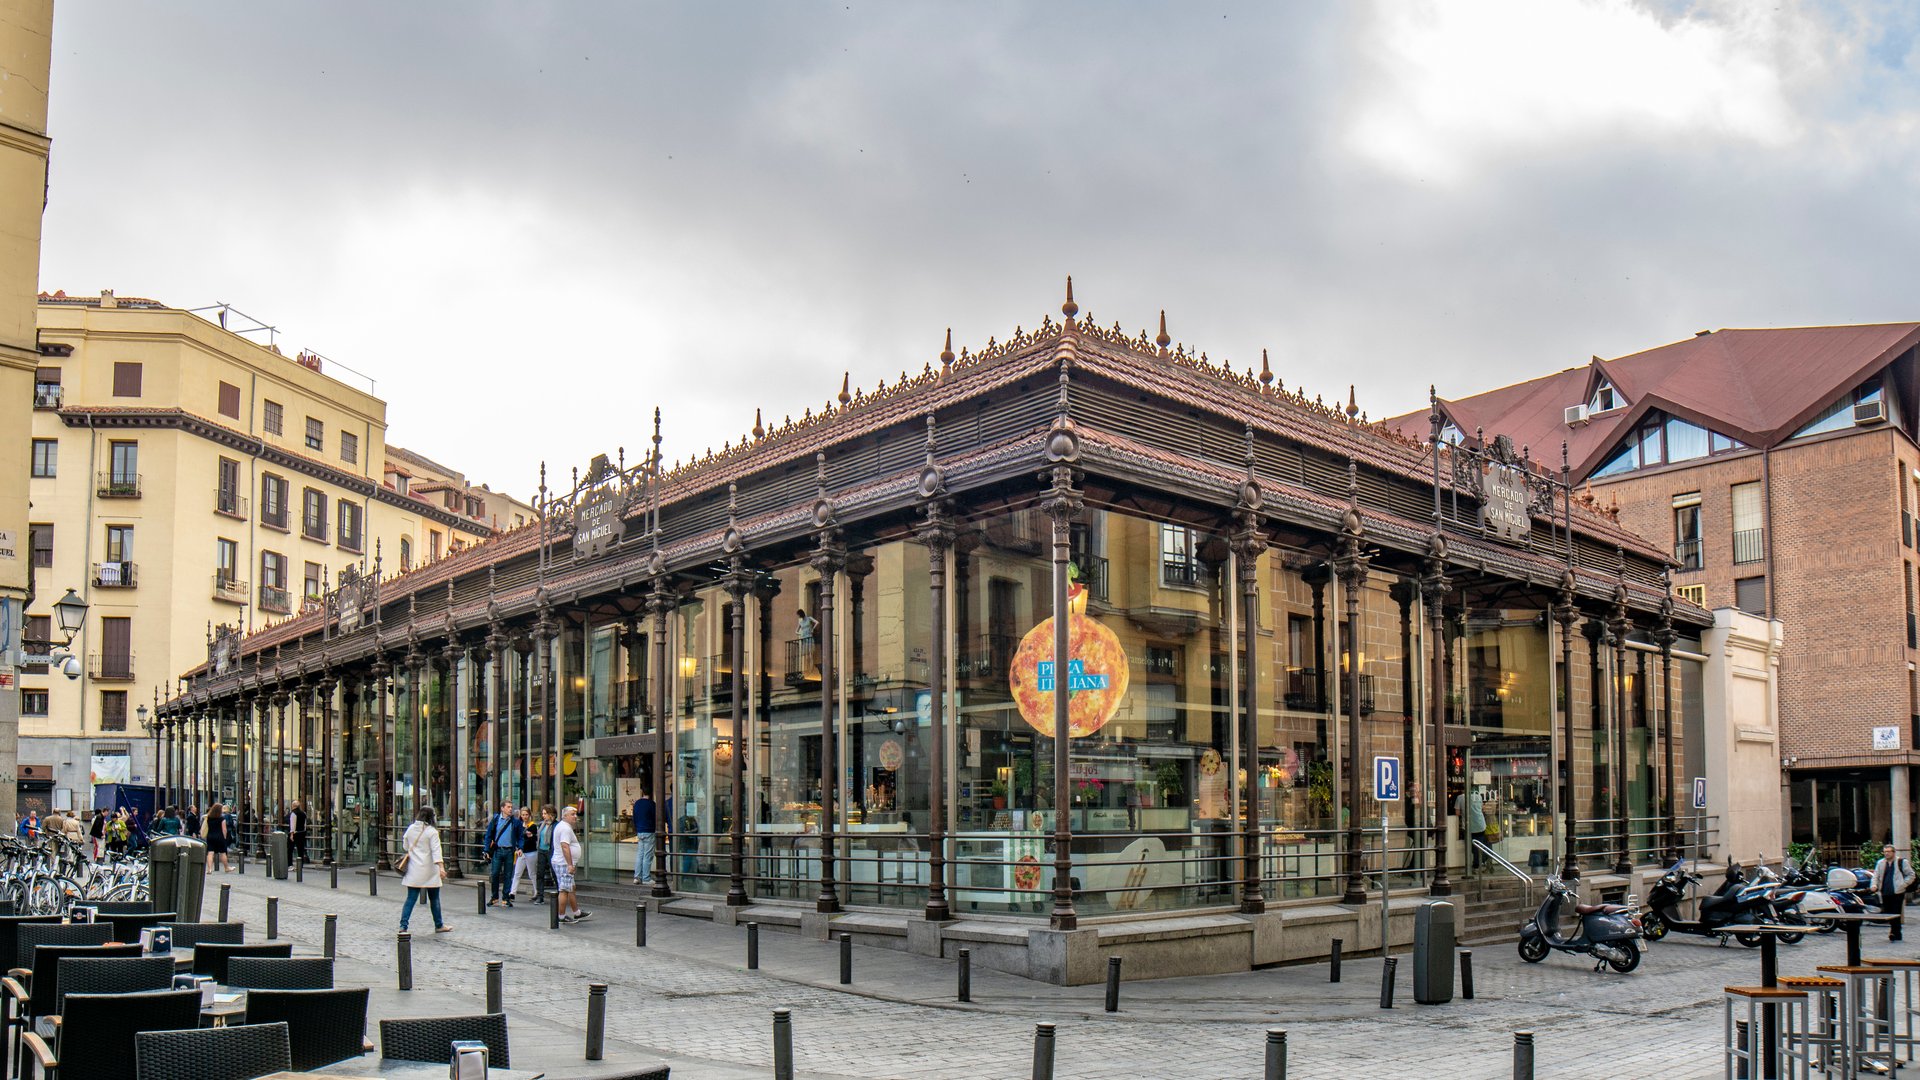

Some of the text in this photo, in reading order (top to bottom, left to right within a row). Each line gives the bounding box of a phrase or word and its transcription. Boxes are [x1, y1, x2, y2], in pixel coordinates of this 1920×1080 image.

[1492, 484, 1524, 504] MERCADO
[581, 501, 613, 521] MERCADO
[1490, 507, 1504, 521] SAN
[1505, 501, 1513, 510] DE
[592, 517, 601, 527] DE
[578, 531, 590, 545] SAN
[1381, 761, 1392, 795] P
[1697, 780, 1703, 805] P
